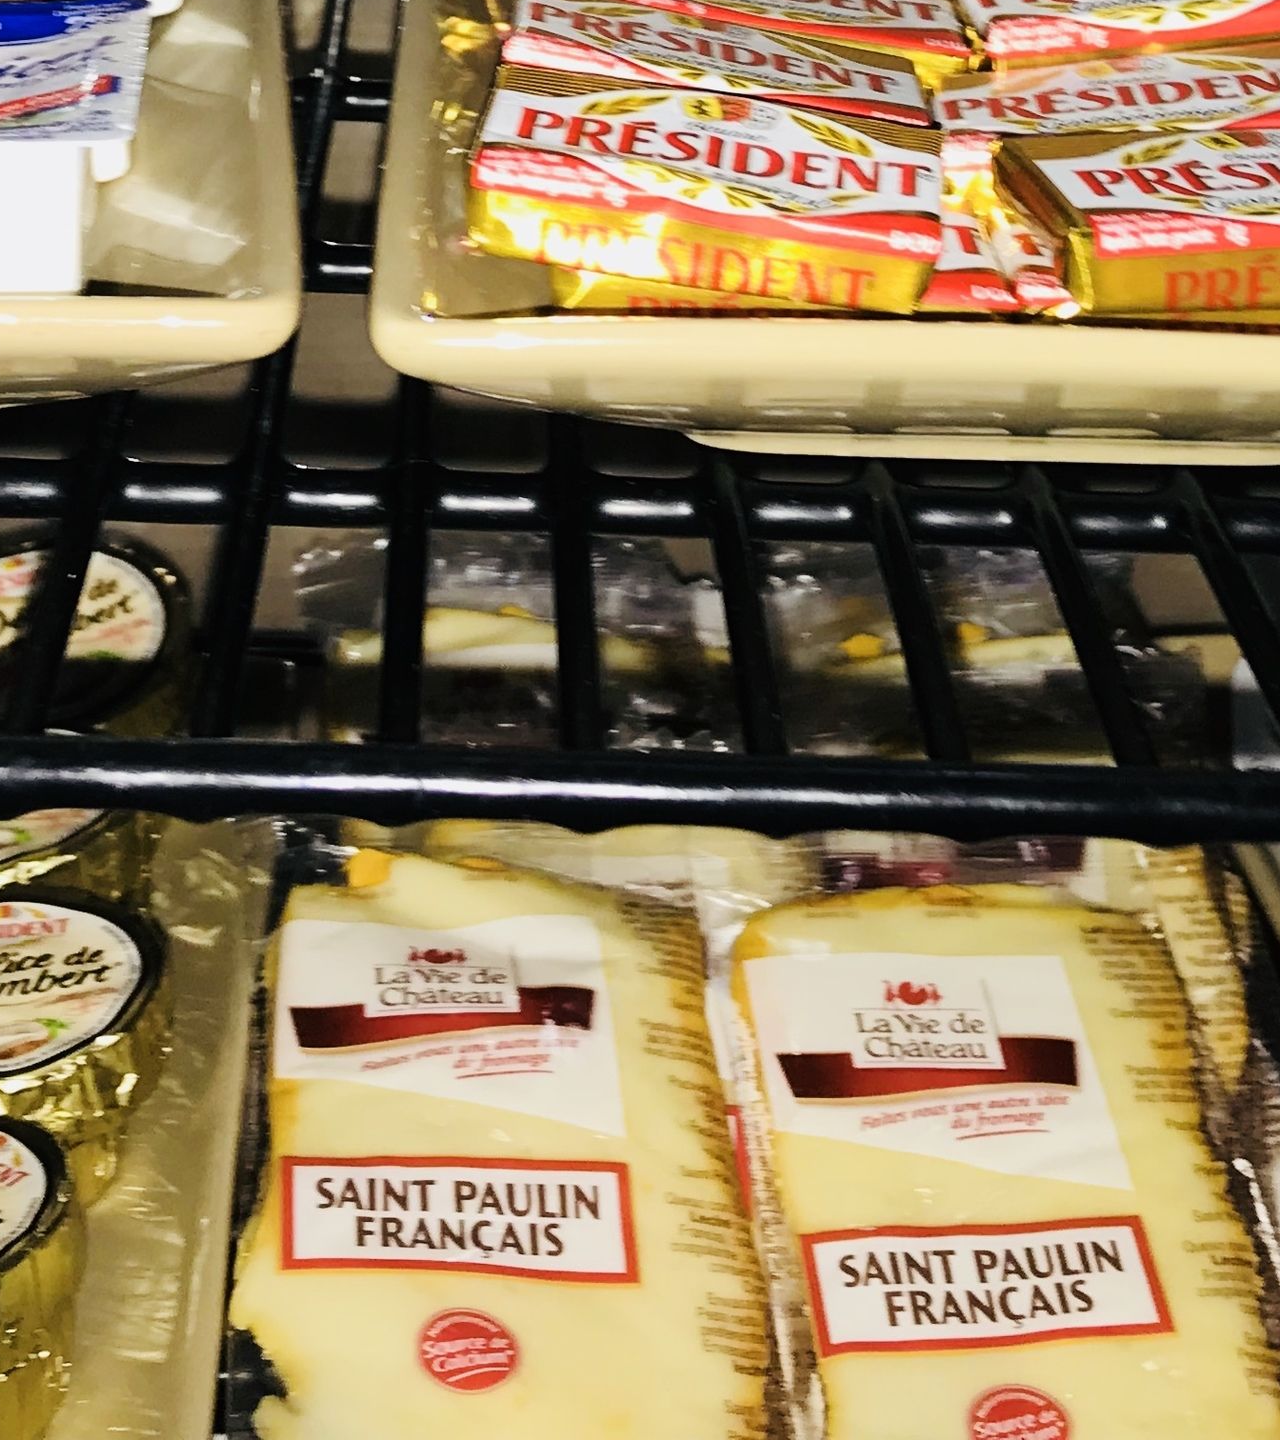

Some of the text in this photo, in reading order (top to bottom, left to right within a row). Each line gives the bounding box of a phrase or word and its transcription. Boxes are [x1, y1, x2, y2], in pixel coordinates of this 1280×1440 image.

[528, 0, 900, 95] PRÉSIDENT
[517, 107, 933, 198] PRÉSIDENT
[64, 945, 106, 967] de
[373, 965, 508, 986] La Vie de
[379, 986, 505, 1008] Château
[854, 1011, 988, 1035] La Vie de
[863, 1036, 991, 1061] Château
[315, 1177, 602, 1221] SAINT PAULIN
[355, 1215, 565, 1259] FRANÇAIS
[837, 1239, 1125, 1288] SAINT PAULIN
[883, 1278, 1095, 1329] FRANÇAIS
